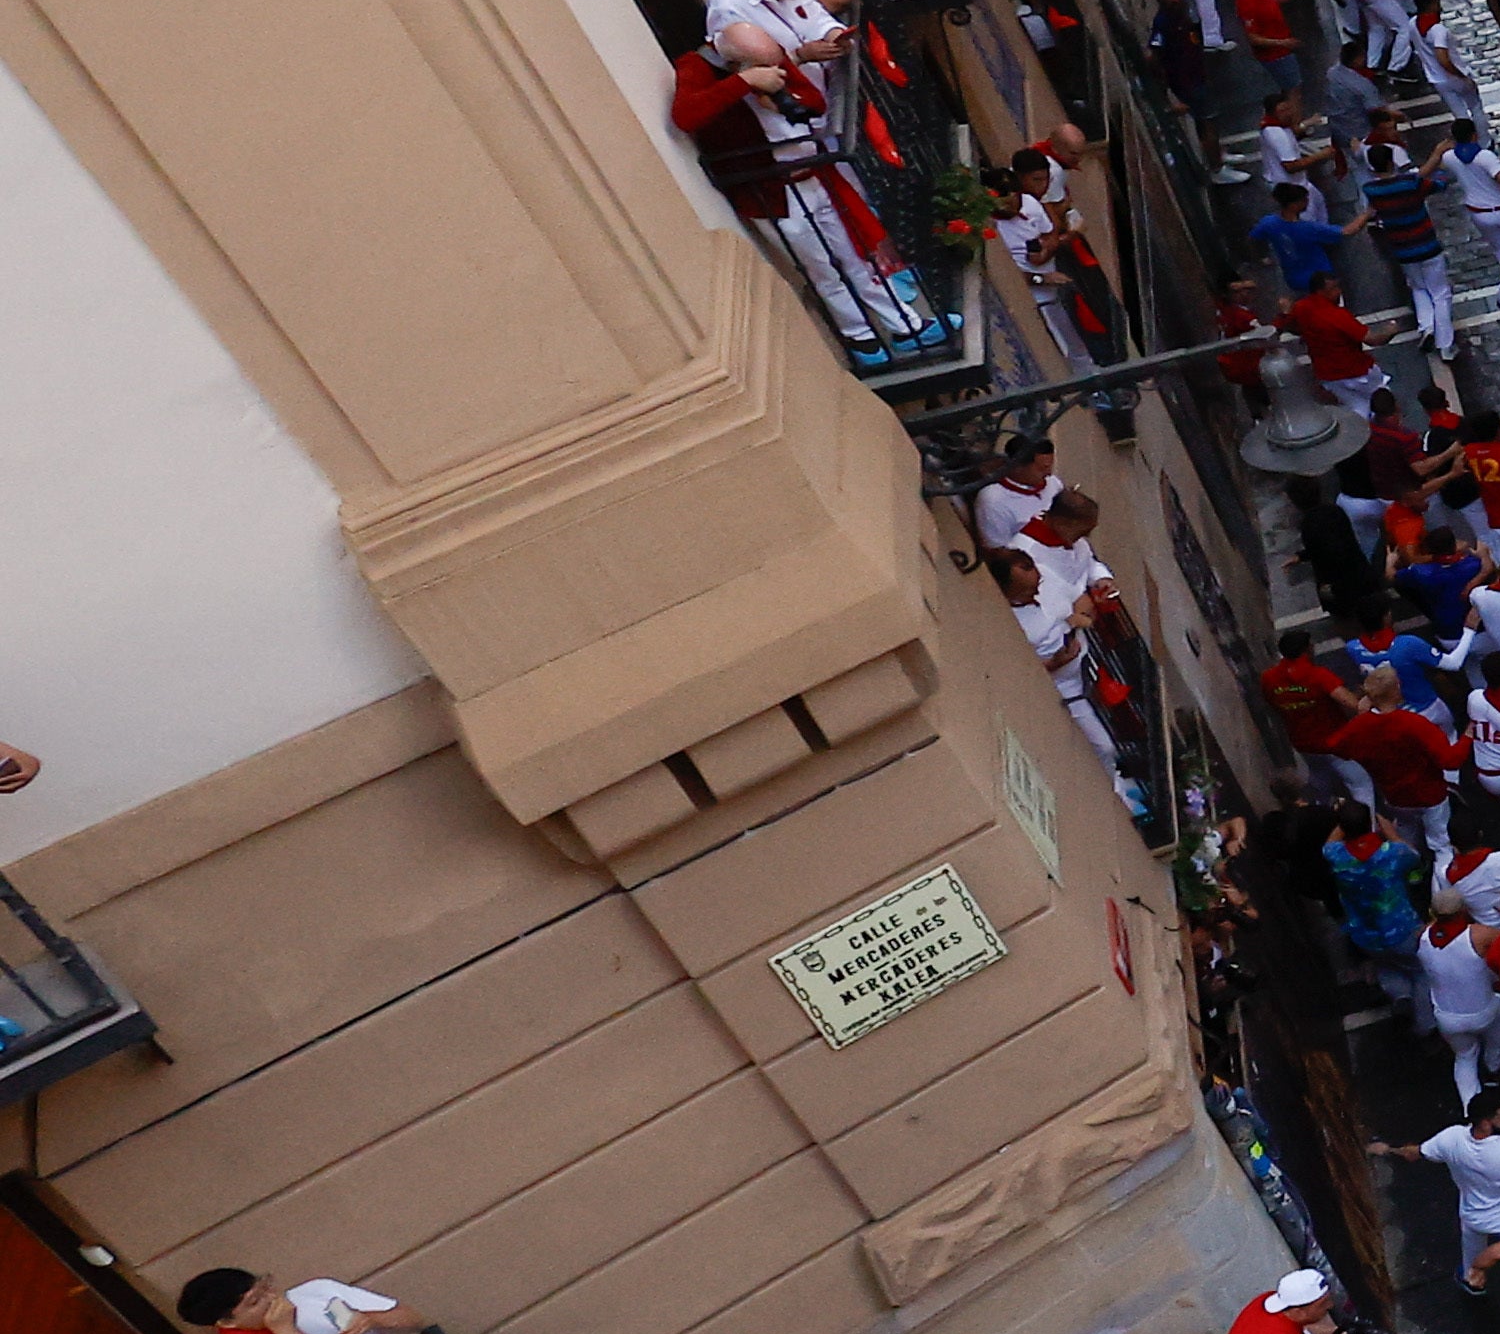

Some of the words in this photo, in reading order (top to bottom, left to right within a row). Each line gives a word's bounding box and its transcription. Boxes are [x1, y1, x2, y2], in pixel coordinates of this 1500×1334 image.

[827, 913, 946, 986] MERCADERES
[848, 913, 903, 950] CALLE
[839, 931, 963, 1007] MERCADERES
[880, 964, 940, 1005] KALEA
